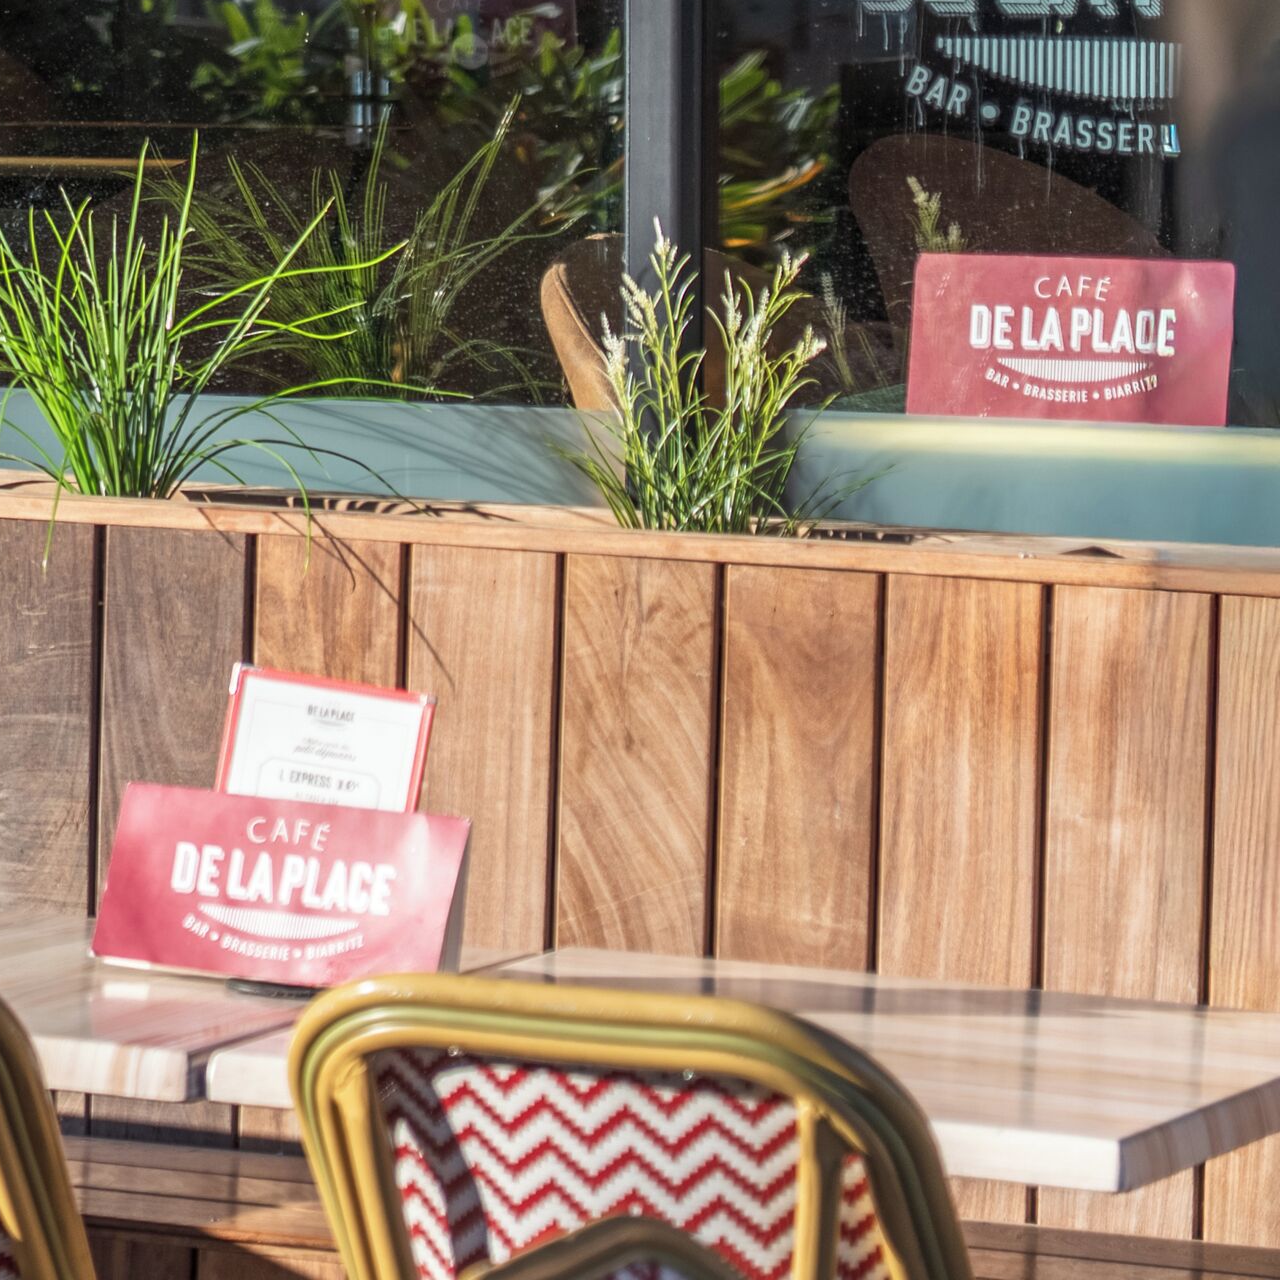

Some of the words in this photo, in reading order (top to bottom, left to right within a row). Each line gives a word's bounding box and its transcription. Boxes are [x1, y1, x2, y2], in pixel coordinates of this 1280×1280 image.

[906, 66, 970, 116] BAR
[1011, 105, 1181, 158] BRASSERI
[1033, 275, 1112, 301] CAFÉ
[969, 304, 1015, 349] DE
[1020, 306, 1064, 351] LA
[1070, 308, 1176, 357] PLACE
[984, 368, 1009, 388] BAR
[1023, 383, 1088, 403] BRASSERIE
[289, 768, 333, 789] EXPRESS
[246, 816, 332, 851] CAFÉ
[170, 840, 225, 898] DE
[226, 847, 274, 904] LA
[278, 853, 398, 917] PLACE
[182, 913, 209, 942] BAR
[221, 934, 291, 962] BRASSERIE
[306, 933, 365, 960] BIARRITZ
